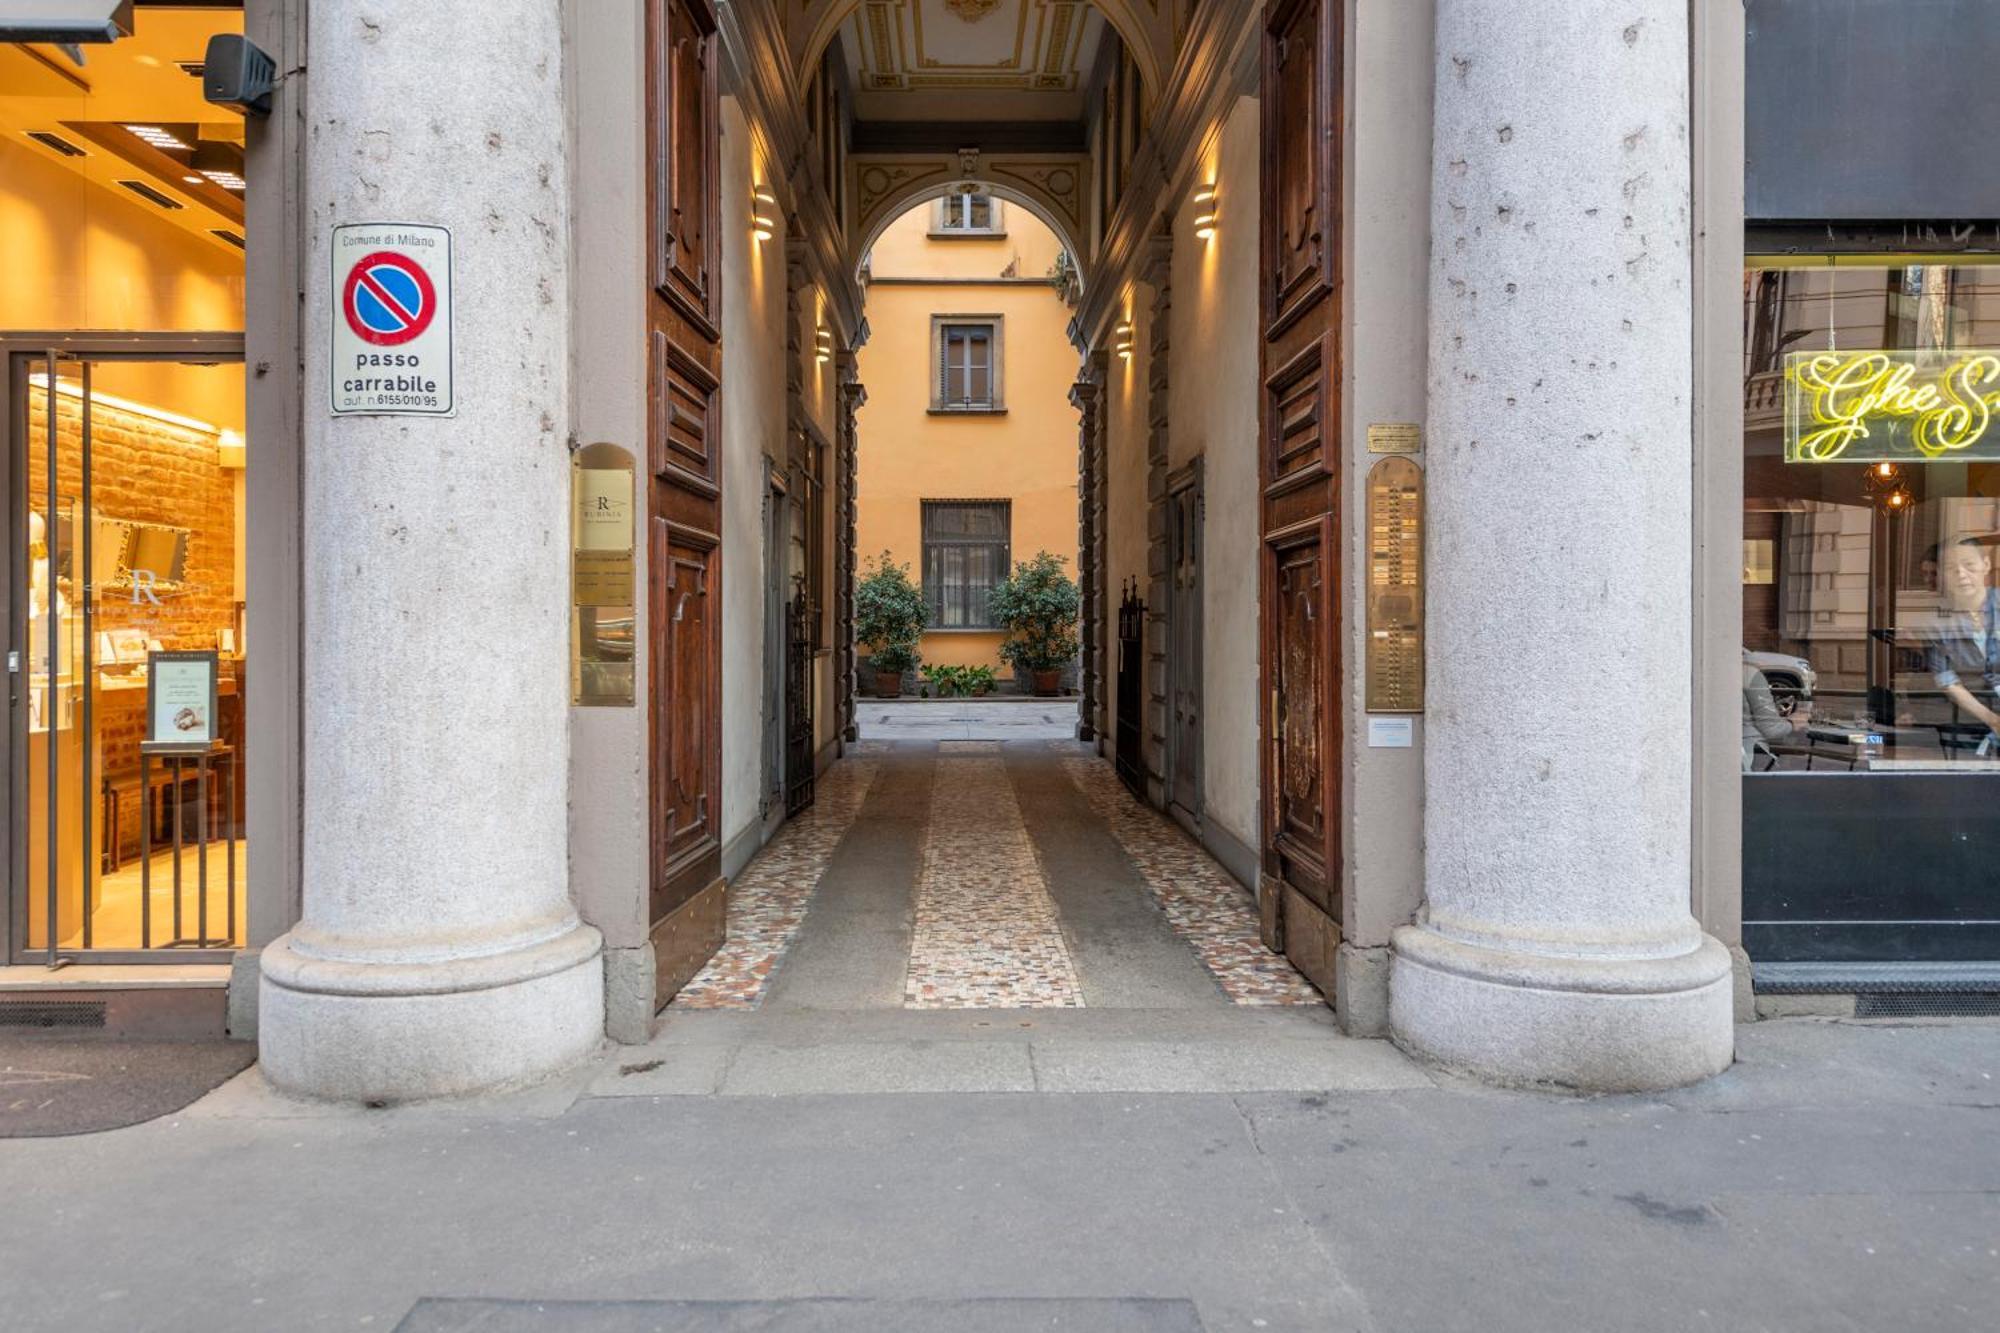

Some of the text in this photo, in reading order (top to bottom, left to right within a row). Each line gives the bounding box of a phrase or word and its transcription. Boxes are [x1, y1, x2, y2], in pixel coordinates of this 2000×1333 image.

[343, 234, 435, 247] Comune di Milano
[356, 353, 419, 371] passo
[343, 375, 437, 393] carrabile
[1936, 356, 2000, 449] S
[597, 496, 609, 510] R
[128, 569, 164, 606] R
